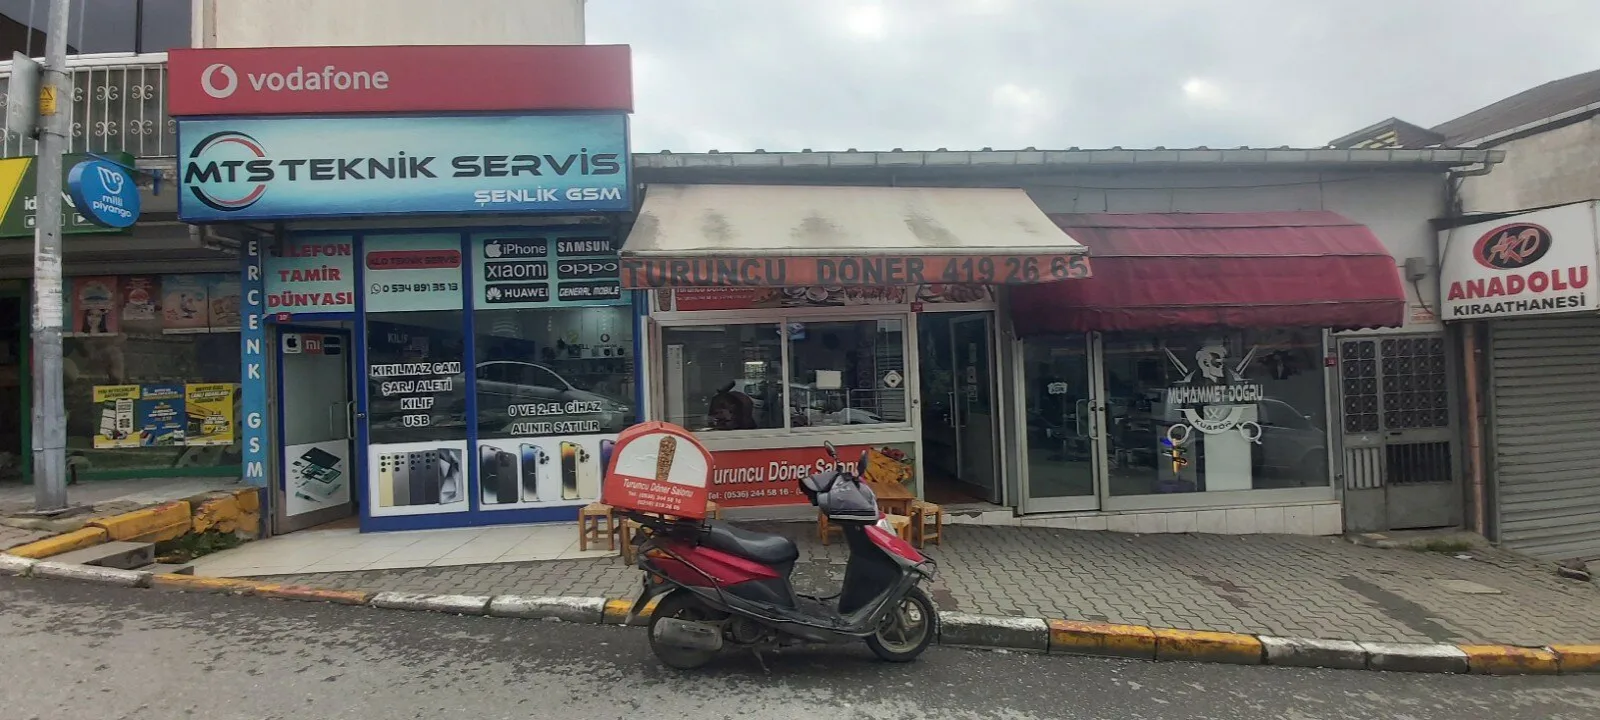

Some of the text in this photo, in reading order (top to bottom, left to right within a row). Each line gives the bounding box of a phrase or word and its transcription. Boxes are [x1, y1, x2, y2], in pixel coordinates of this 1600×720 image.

[248, 66, 389, 91] vodafone
[184, 147, 620, 184] MTS TEKNİK SERVİS
[102, 195, 123, 206] milli
[474, 186, 621, 208] ŞENLİK GSM
[92, 200, 132, 218] piyango
[503, 243, 547, 255] iPhone
[557, 240, 615, 253] SAMSUN
[278, 265, 341, 282] TAMİR
[558, 262, 618, 275] oppo
[622, 257, 786, 287] TURUNCU
[942, 257, 995, 283] 419
[1003, 256, 1040, 283] 26
[1051, 255, 1089, 281] 65
[382, 282, 459, 293] 0 534 891 35 13
[558, 285, 620, 297] GENERAL MOBILE
[1447, 265, 1588, 301] ANADOLU
[267, 290, 353, 307] DÜNYASI
[504, 287, 549, 299] HUAWEI
[1453, 292, 1586, 316] KIRAATHANESİ
[371, 362, 461, 376] KIRILMAZ CAM
[381, 377, 452, 395] ŞARJ ALETİ
[1167, 381, 1264, 404] MUHAMMET DOĞRU
[401, 397, 434, 410] KILIF
[519, 404, 536, 416] VE
[565, 398, 602, 413] CİHAZ
[403, 414, 430, 427] USB
[511, 420, 600, 435] ALINIR SATILIR
[713, 464, 765, 485] uruncu
[768, 459, 810, 481] Döner
[623, 478, 650, 491] Turuncu
[671, 486, 694, 498] Salonu
[724, 490, 749, 500] (0536)
[750, 489, 765, 498] 244
[767, 488, 777, 496] 58
[779, 488, 789, 496] 16
